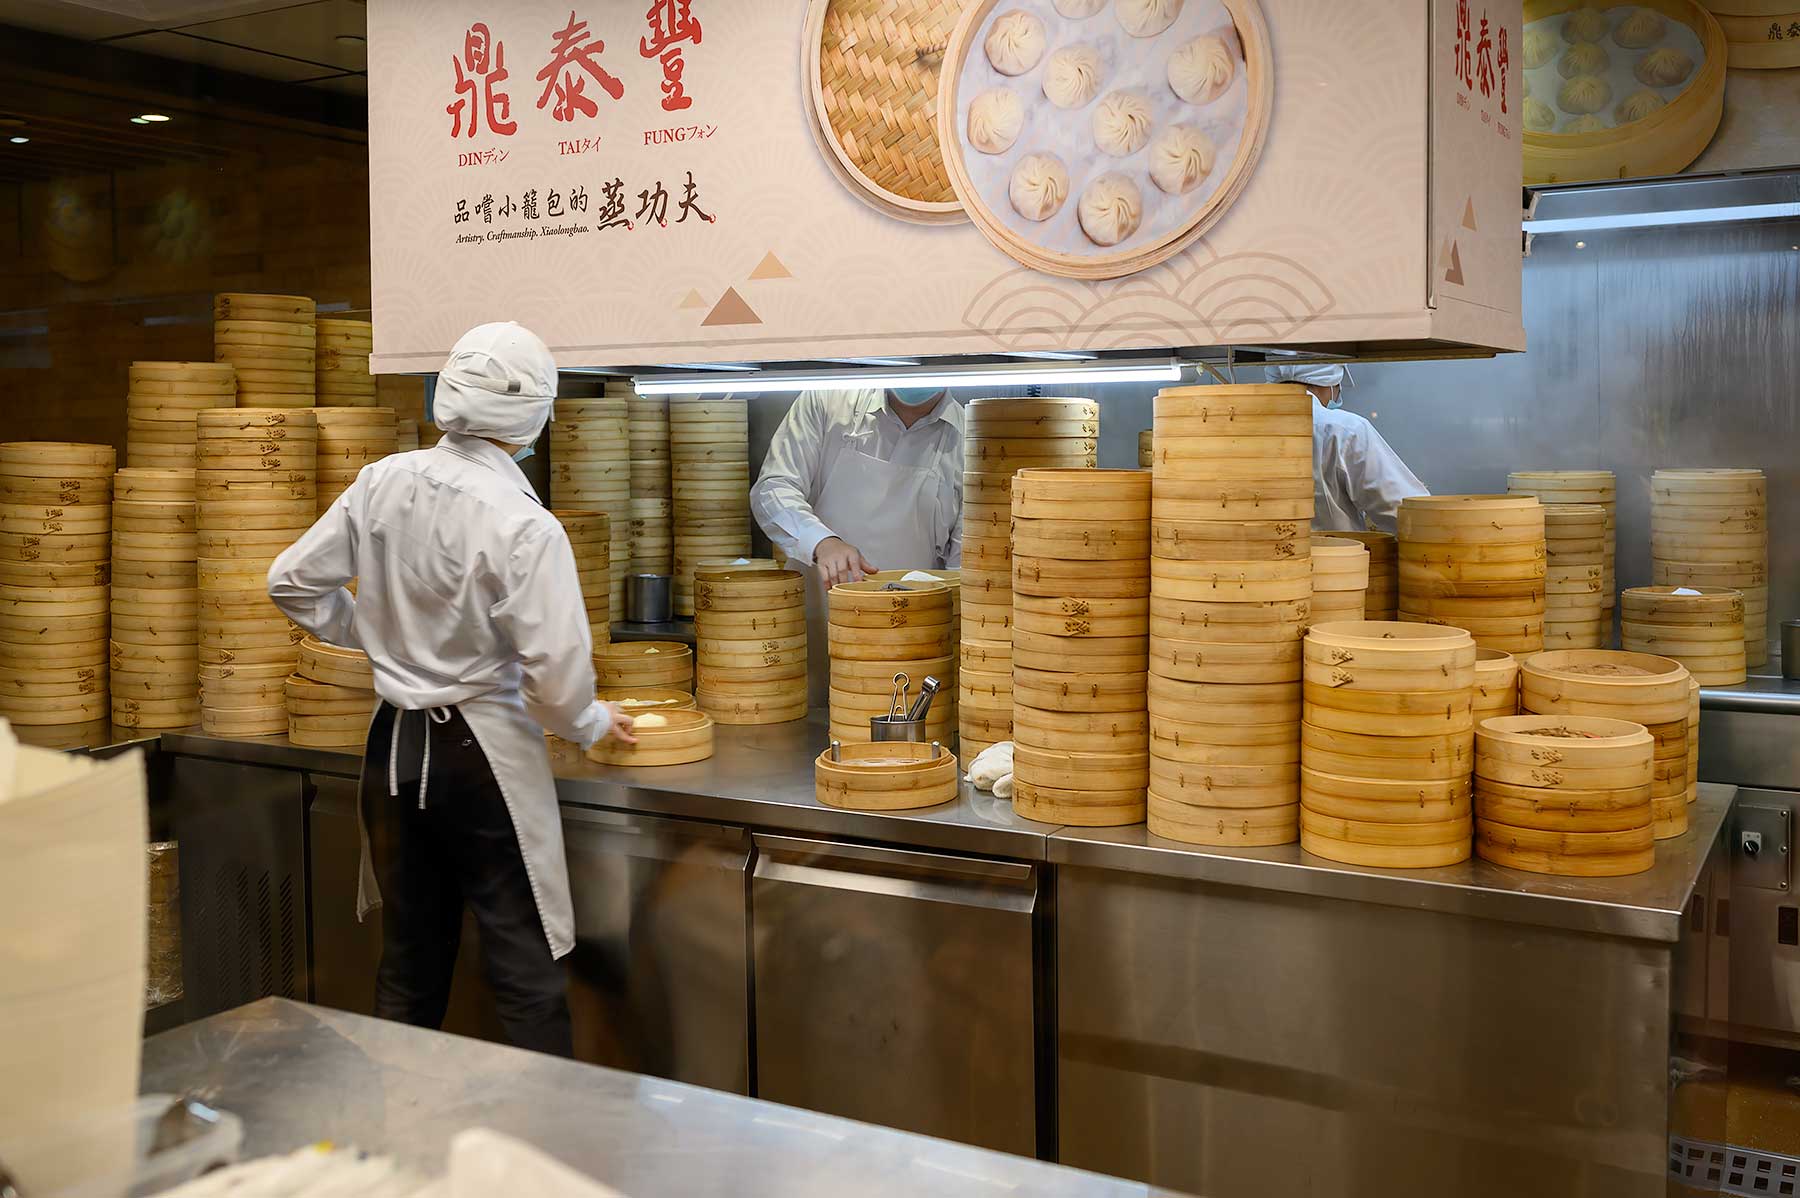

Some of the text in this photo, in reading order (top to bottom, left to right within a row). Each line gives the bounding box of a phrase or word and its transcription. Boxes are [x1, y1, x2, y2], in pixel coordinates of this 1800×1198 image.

[446, 0, 702, 138] 鼎泰豐
[456, 223, 590, 245] Artistry. Craftmanship. Xiaolongbao.
